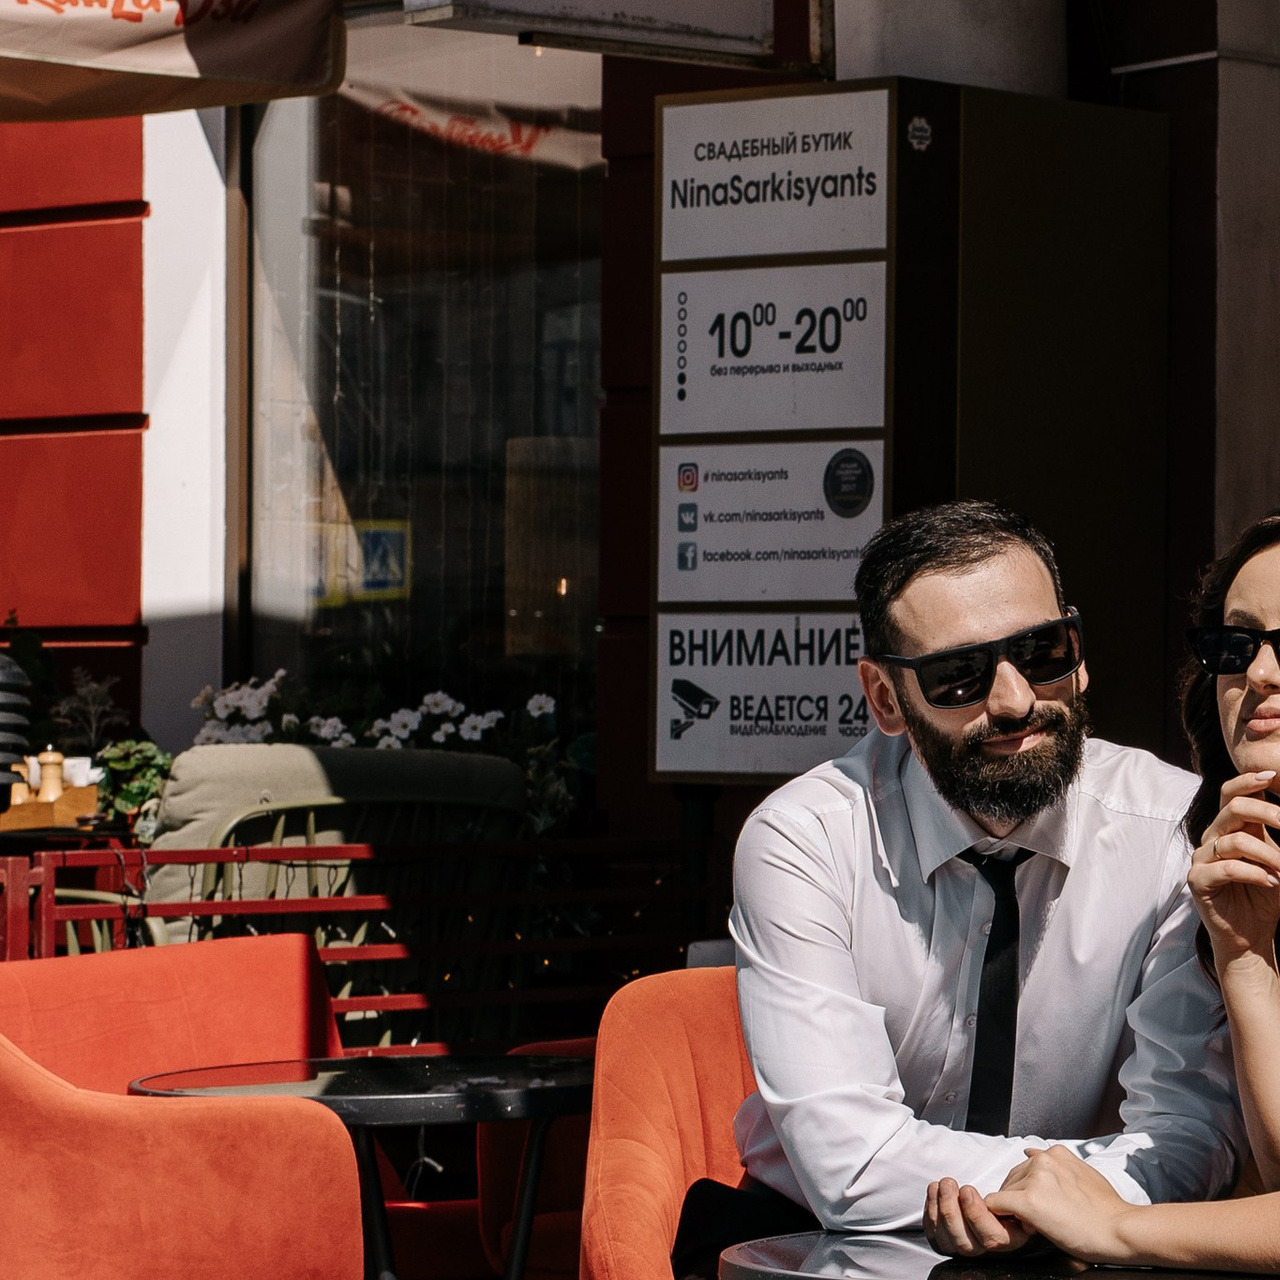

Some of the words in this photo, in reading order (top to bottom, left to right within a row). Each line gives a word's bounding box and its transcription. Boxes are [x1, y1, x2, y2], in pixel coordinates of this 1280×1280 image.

[694, 132, 798, 162] СВАДЕБНЫЙ
[801, 131, 853, 153] БУТИК
[671, 166, 877, 209] NinaSarkisyants
[710, 363, 728, 376] без
[729, 363, 781, 377] перерыва
[782, 364, 790, 373] и
[791, 361, 844, 374] выходных
[703, 508, 825, 524] vk.com/ninasarkisyants
[669, 628, 866, 666] ВНИМАНИЕ
[730, 695, 828, 726] ВЕДЕТСЯ
[838, 693, 869, 725] 24
[730, 724, 827, 737] ВИДЕОНАБЛЮДЕНИЕ
[839, 726, 868, 737] часа
